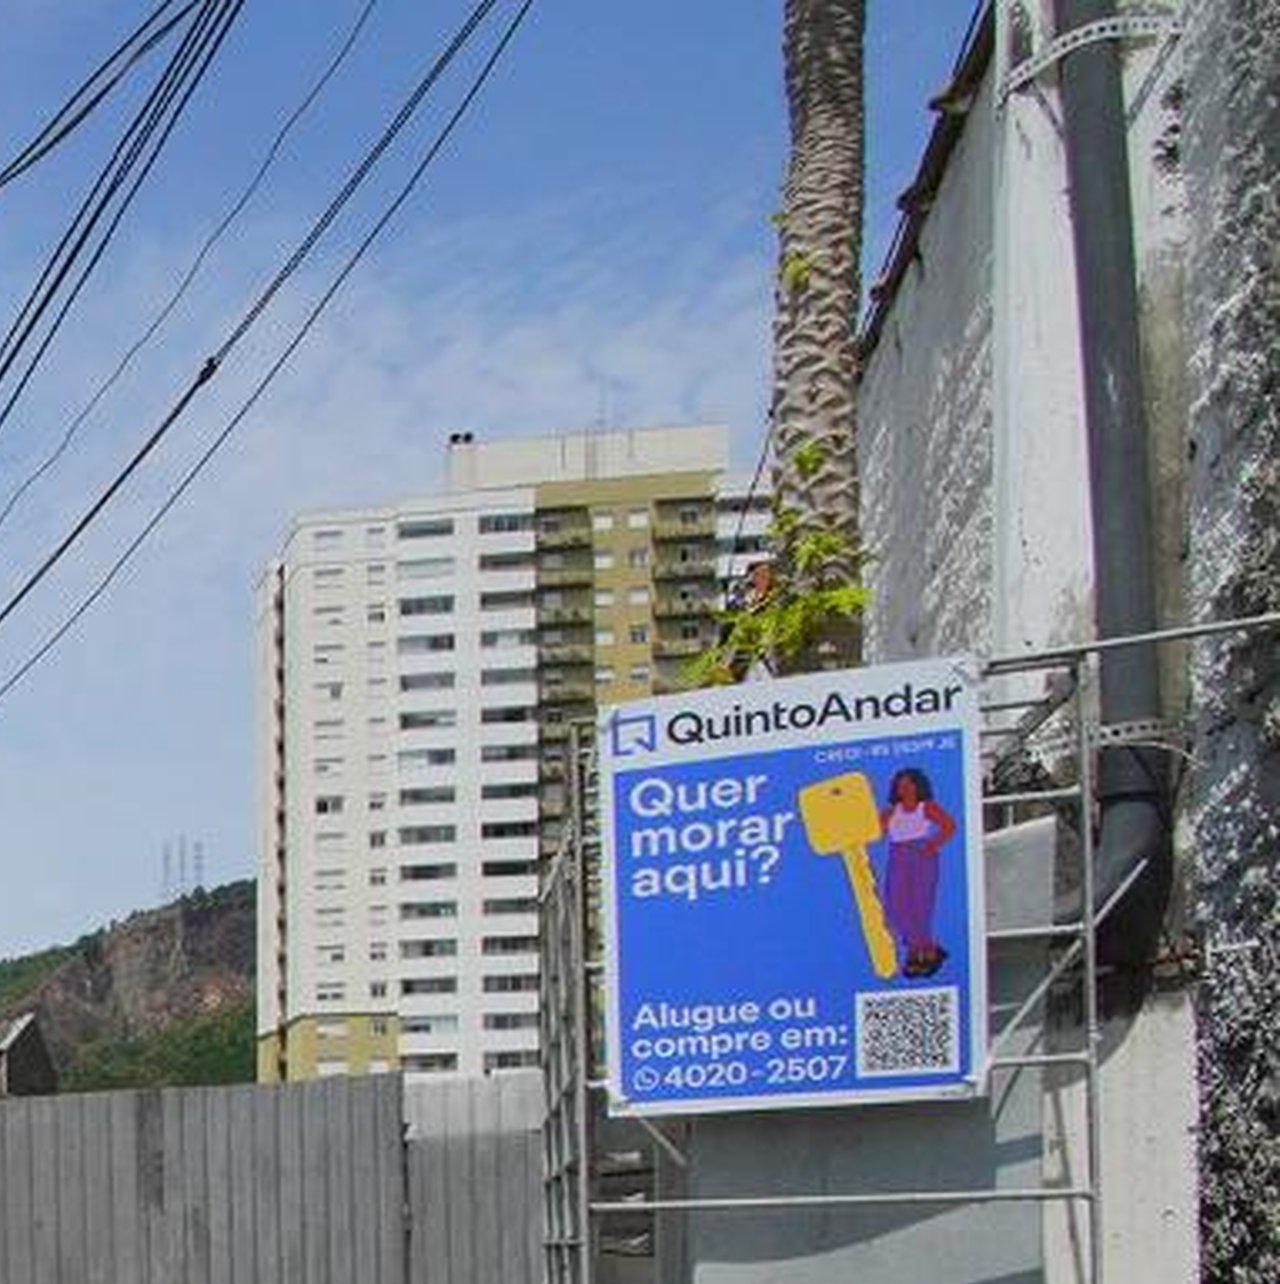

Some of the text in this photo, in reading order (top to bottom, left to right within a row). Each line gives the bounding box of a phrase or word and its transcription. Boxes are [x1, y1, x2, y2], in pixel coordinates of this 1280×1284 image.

[666, 683, 962, 745] QuintoAndar
[628, 773, 769, 818] Quer
[630, 810, 795, 858] morar
[631, 845, 781, 900] aqui?
[632, 998, 816, 1033] Alugue ou
[631, 1024, 848, 1060] compre em:
